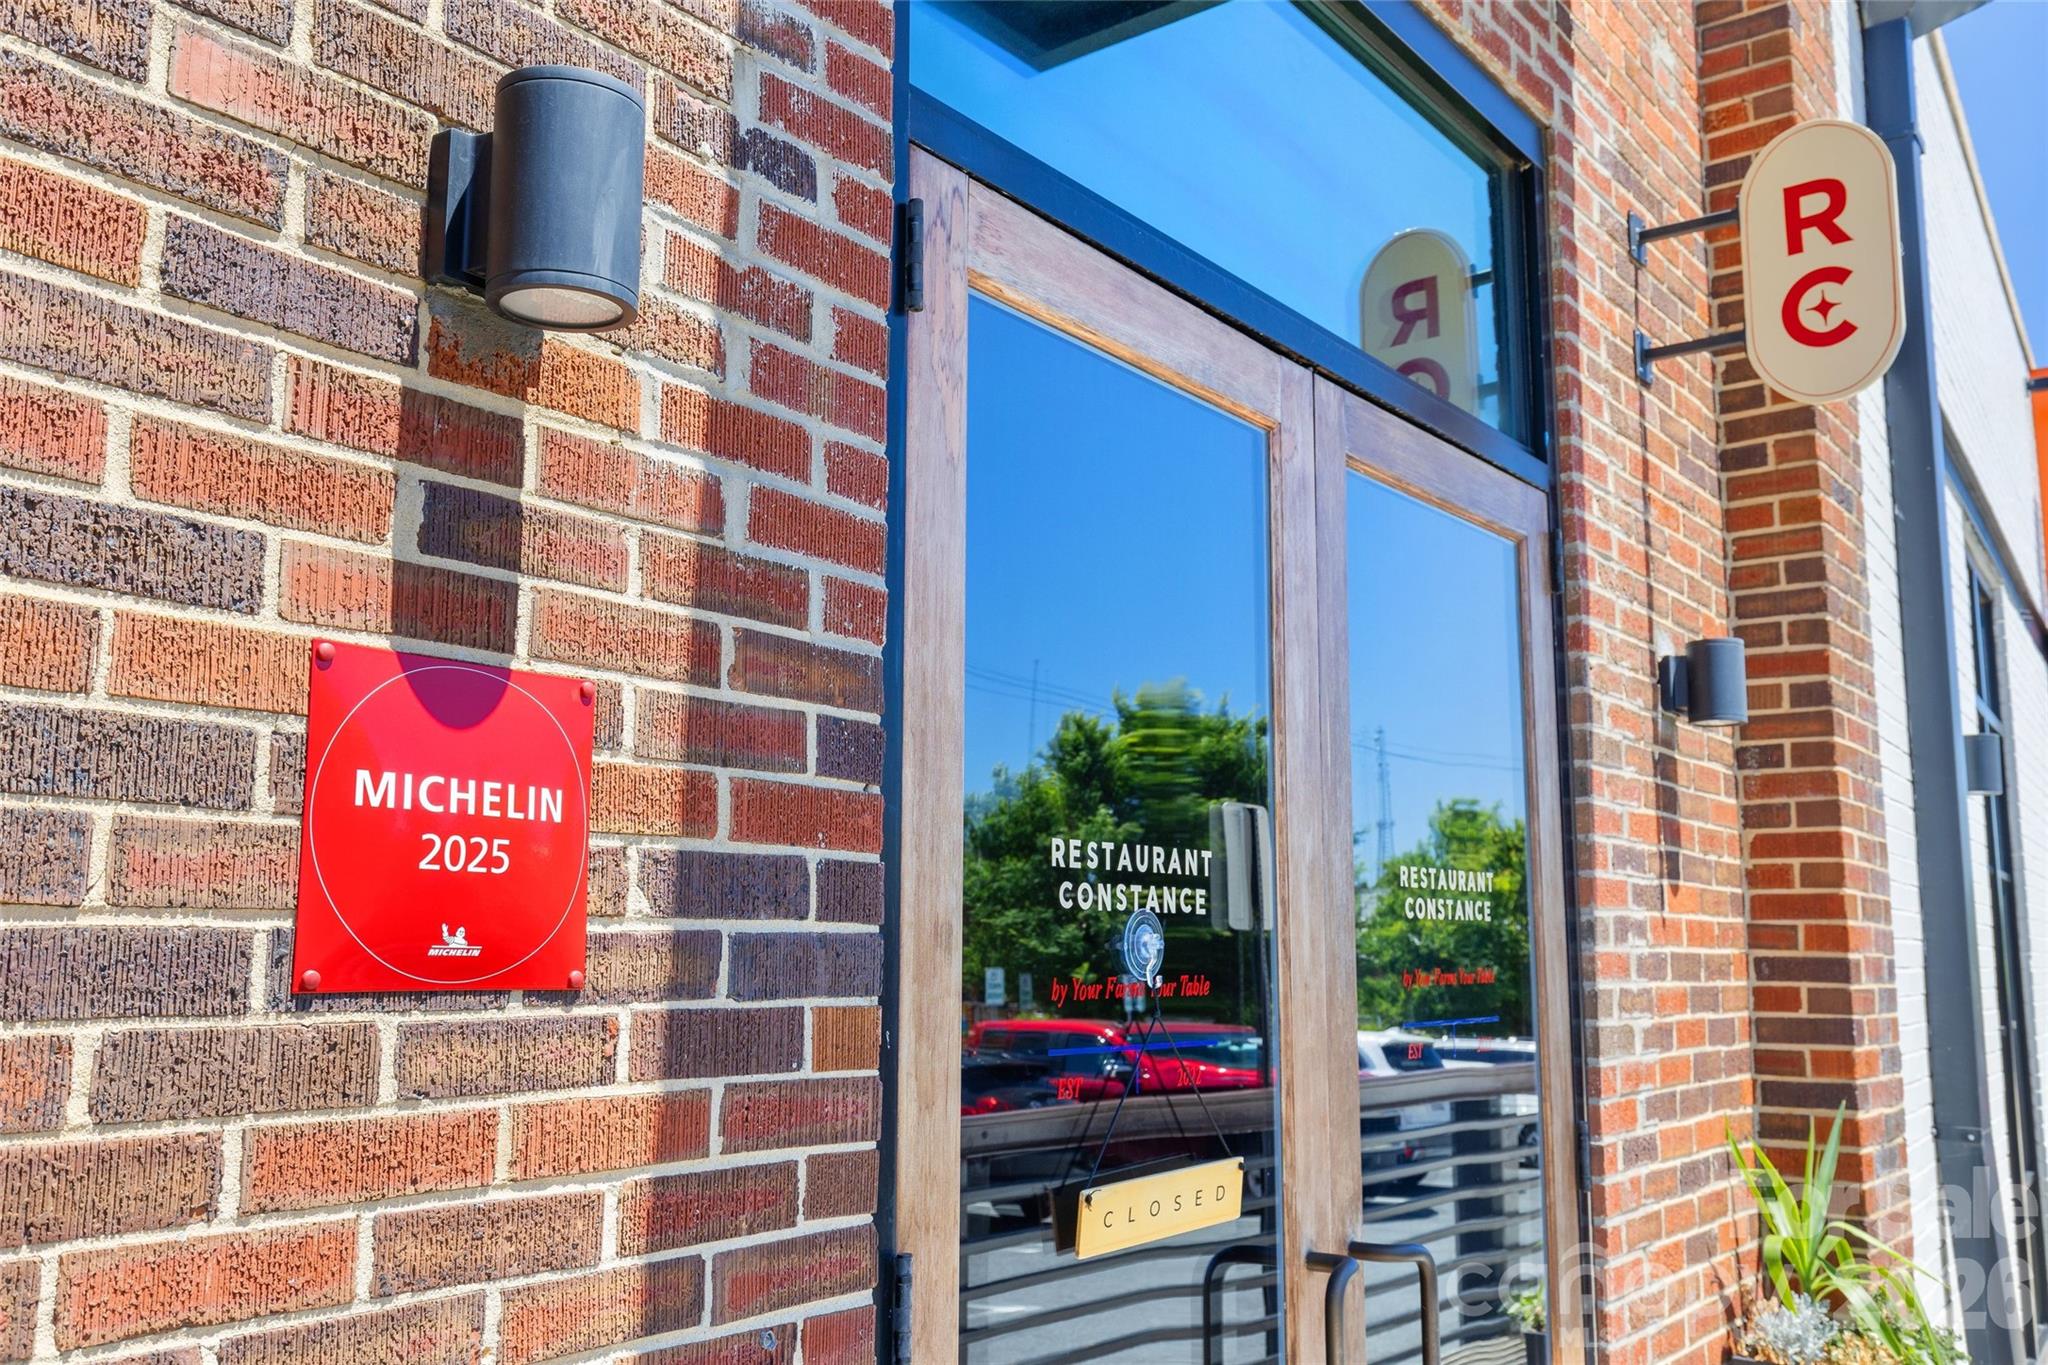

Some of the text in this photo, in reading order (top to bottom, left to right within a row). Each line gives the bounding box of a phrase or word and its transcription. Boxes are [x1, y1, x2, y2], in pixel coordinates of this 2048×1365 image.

[354, 769, 563, 823] MICHELIN
[418, 833, 510, 874] 2025
[1051, 838, 1212, 877] RESTAURANT
[1400, 866, 1494, 892] RESTAURANT
[1059, 881, 1206, 915] CONSTANCE
[1405, 897, 1491, 922] CONSTANCE
[428, 948, 480, 956] MICHELIN
[1051, 977, 1067, 1008] by
[1072, 977, 1102, 1001] Your
[1180, 975, 1211, 997] Table
[1408, 1042, 1423, 1060] EST
[1057, 1077, 1084, 1100] EST
[1104, 1185, 1225, 1228] CLOSED
